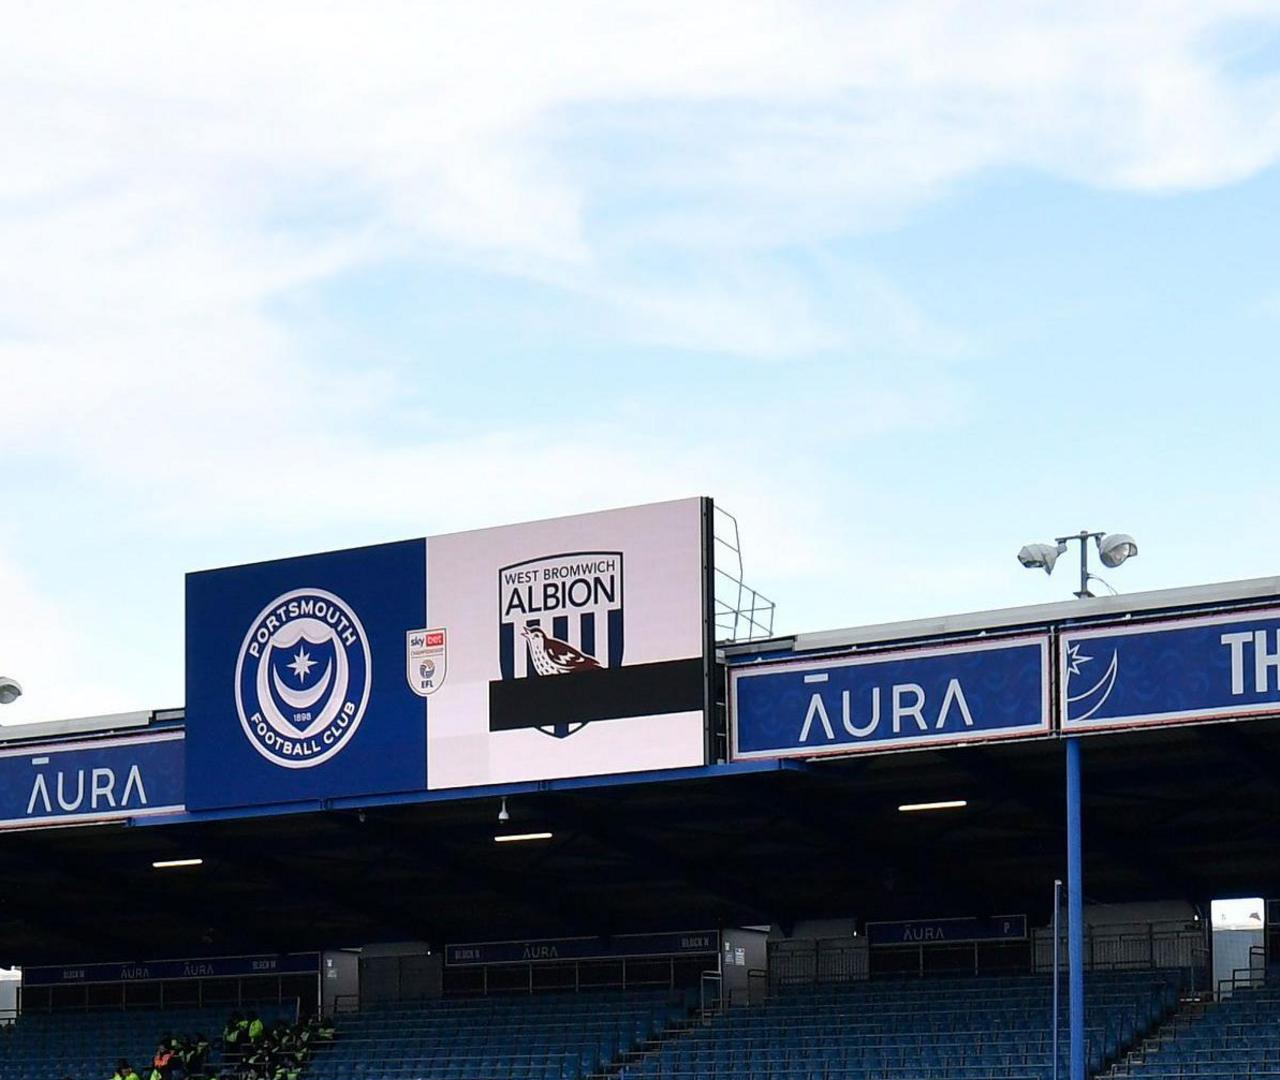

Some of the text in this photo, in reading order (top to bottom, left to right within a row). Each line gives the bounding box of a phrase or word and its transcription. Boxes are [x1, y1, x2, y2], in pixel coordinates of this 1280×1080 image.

[504, 561, 615, 586] WEST BROMWICH
[505, 575, 615, 616] ALBION
[249, 599, 357, 657] PORTSMOUTH
[251, 701, 356, 756] FOOTBALL CLUB
